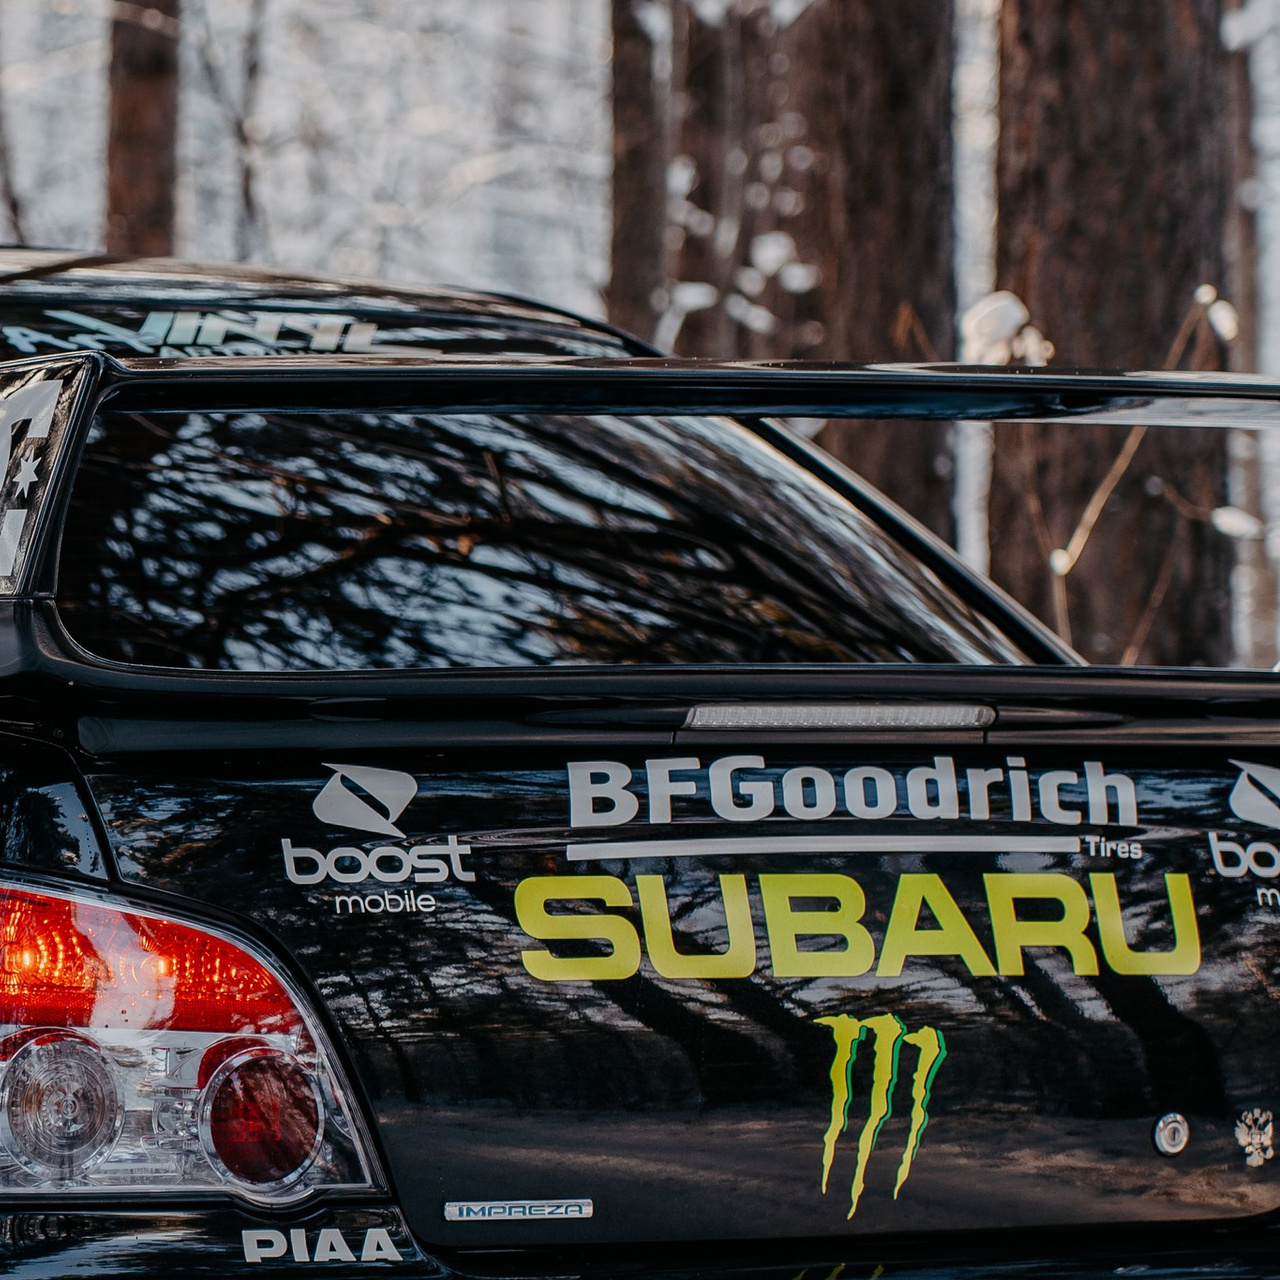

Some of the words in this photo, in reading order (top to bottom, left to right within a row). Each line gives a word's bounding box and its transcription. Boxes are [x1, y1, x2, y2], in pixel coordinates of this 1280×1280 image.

[566, 755, 1138, 829] BFGoodrich
[281, 836, 476, 885] boost
[1083, 835, 1142, 861] Tires
[334, 889, 437, 914] mobile
[513, 873, 1202, 980] SUBARU
[458, 1204, 583, 1218] IMPREZA
[242, 1228, 403, 1263] PIAA
